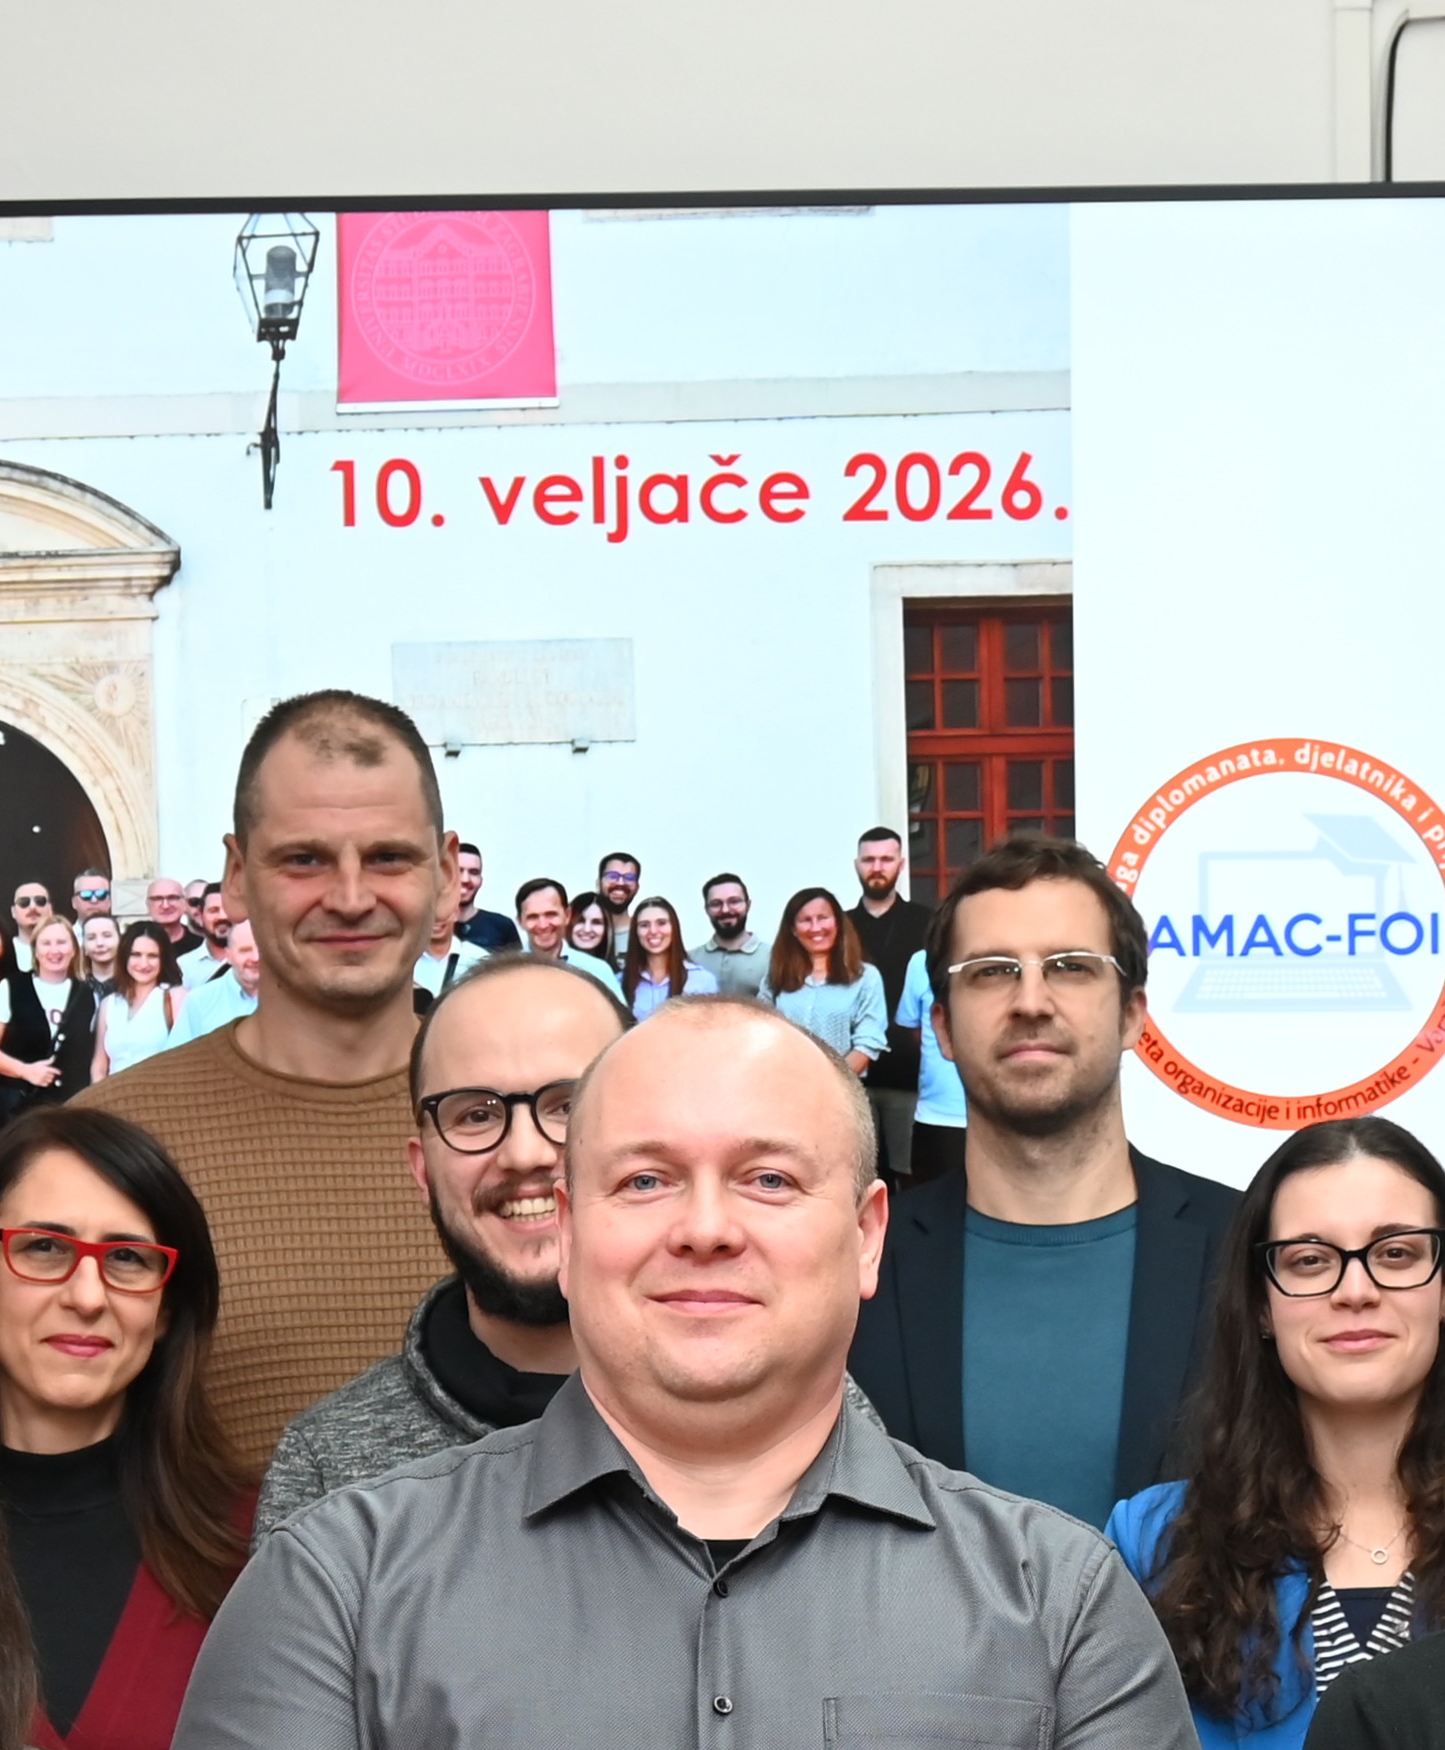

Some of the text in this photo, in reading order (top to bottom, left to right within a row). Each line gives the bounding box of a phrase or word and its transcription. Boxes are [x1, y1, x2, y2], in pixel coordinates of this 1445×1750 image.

[330, 451, 1069, 543] 10. veljače 2026.
[1293, 743, 1417, 811] djelatnika
[1417, 807, 1435, 824] i
[1148, 911, 1440, 957] AMAC-FOI
[1163, 1058, 1280, 1124] organizacije
[1284, 1100, 1292, 1121] i
[1296, 1065, 1412, 1121] informatike
